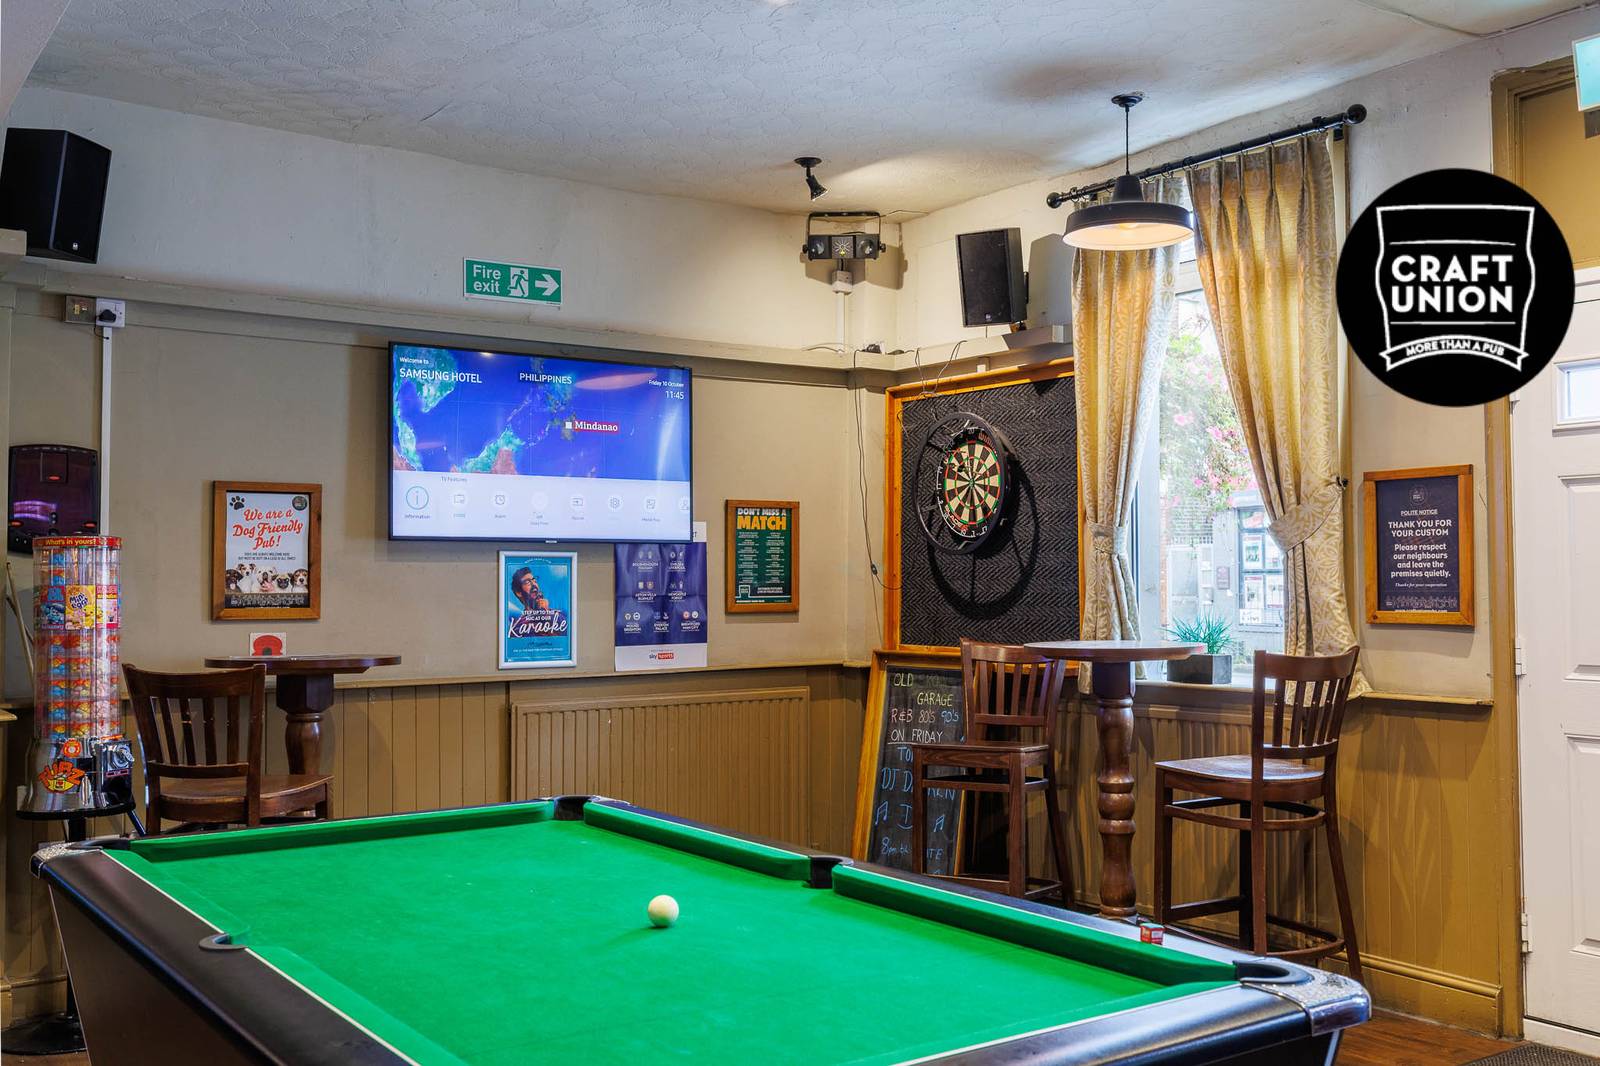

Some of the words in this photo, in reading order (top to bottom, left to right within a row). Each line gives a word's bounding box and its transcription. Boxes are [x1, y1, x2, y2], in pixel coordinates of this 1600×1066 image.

[473, 264, 501, 280] Fire
[473, 280, 500, 293] exit
[399, 367, 449, 381] SAMSUNG
[452, 372, 483, 384] HOTEL
[519, 372, 573, 384] PHILIPPINES
[648, 379, 662, 387] Friday
[665, 390, 685, 400] 11:45
[575, 420, 618, 432] Mindanao
[243, 508, 264, 522] We
[265, 510, 284, 519] are
[285, 509, 294, 518] a
[737, 507, 761, 516] DON'T
[762, 508, 780, 516] MISS
[1419, 508, 1438, 516] NOTICE
[232, 524, 256, 538] Dog
[257, 519, 304, 536] Friendly
[736, 515, 787, 531] MATCH
[1388, 520, 1415, 529] THANK
[1416, 520, 1434, 528] YOU
[1435, 519, 1452, 528] FOR
[1415, 528, 1449, 537] CUSTOM
[75, 538, 97, 546] yours?
[1419, 543, 1447, 552] respect
[1407, 552, 1449, 561] neighbours
[1432, 560, 1445, 568] the
[1391, 570, 1423, 578] premises
[1424, 569, 1451, 578] quietly.
[508, 611, 568, 638] Karaoke
[649, 652, 657, 660] sky
[893, 673, 913, 687] OLD
[917, 692, 953, 707] GARAGE
[891, 708, 913, 723] R&B
[890, 729, 905, 742] ON
[911, 728, 943, 744] FRIDAY
